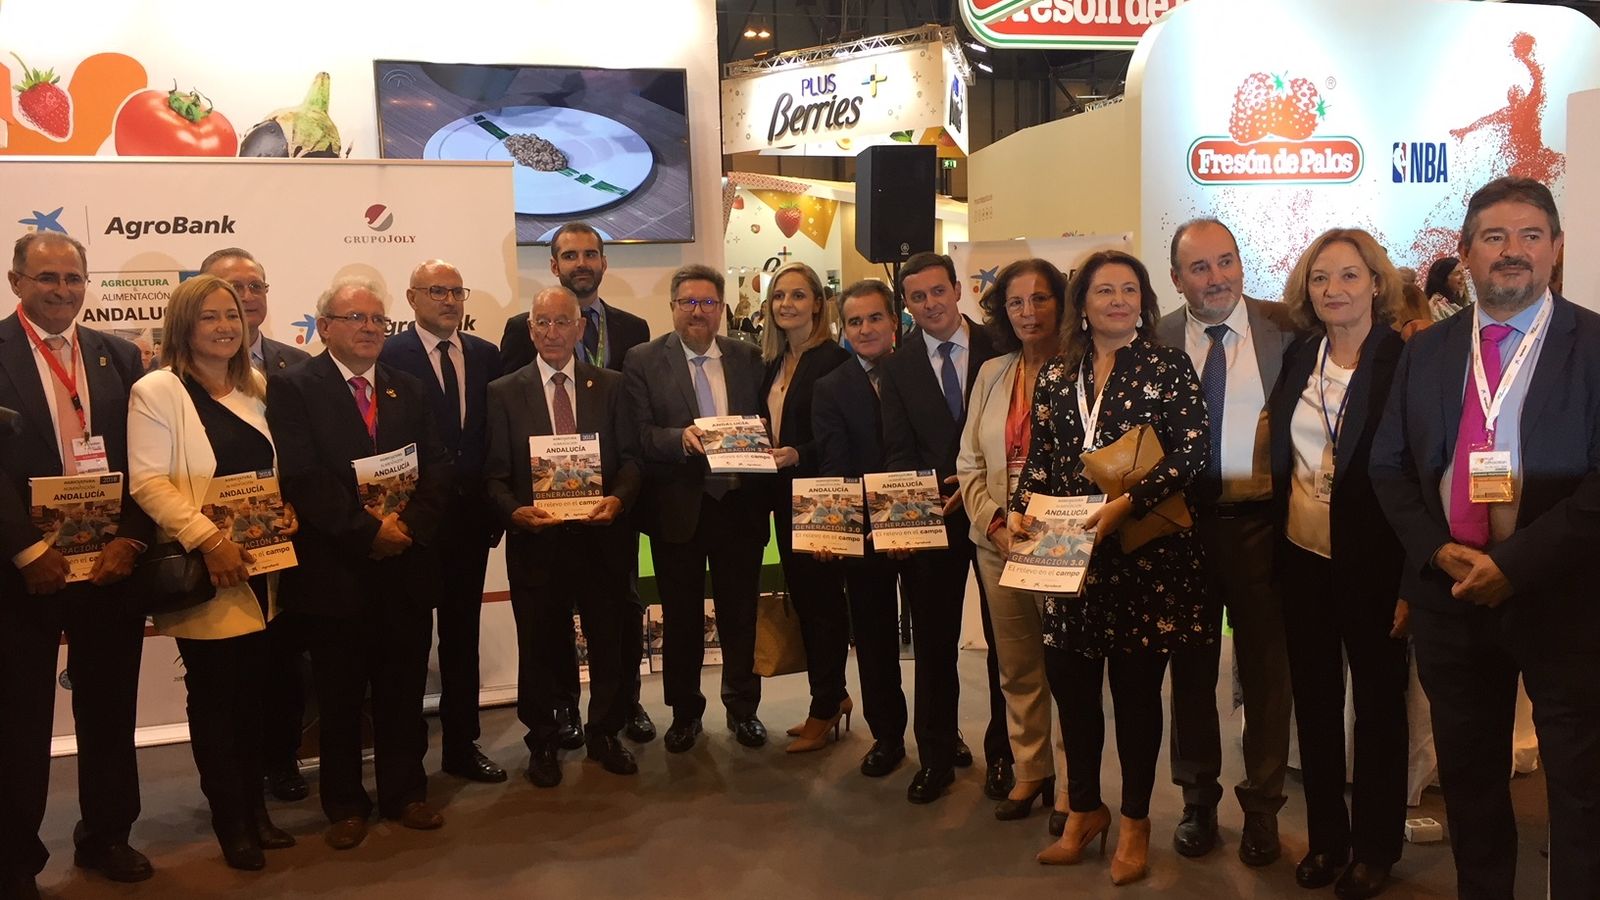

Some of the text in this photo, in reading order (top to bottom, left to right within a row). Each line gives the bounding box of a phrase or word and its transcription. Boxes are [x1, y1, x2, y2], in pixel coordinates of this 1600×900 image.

[801, 73, 837, 97] PLUS
[767, 92, 863, 145] Berries
[1198, 148, 1354, 175] Fresón de Palos
[1410, 142, 1448, 183] NBA
[104, 215, 237, 240] AgroBank
[101, 279, 169, 288] AGRICULTURA
[101, 291, 171, 302] ALIMENTACIÓN
[83, 306, 167, 322] ANDALU
[546, 445, 586, 453] ANDALUCÍA
[374, 461, 410, 478] ANDALUCÍA
[882, 480, 924, 489] ANDALUCÍA
[53, 489, 106, 501] ANDALUCÍA
[219, 484, 265, 499] ANDALUCÍA
[535, 489, 586, 499] GENERACIÓN
[1044, 508, 1088, 516] ANDALUCÍA
[794, 524, 846, 532] GENERACIÓN
[874, 520, 927, 529] GENERACIÓN
[838, 535, 861, 543] campo
[266, 546, 290, 556] campo
[1011, 554, 1069, 566] GENERACIÓN
[1055, 570, 1081, 578] campo
